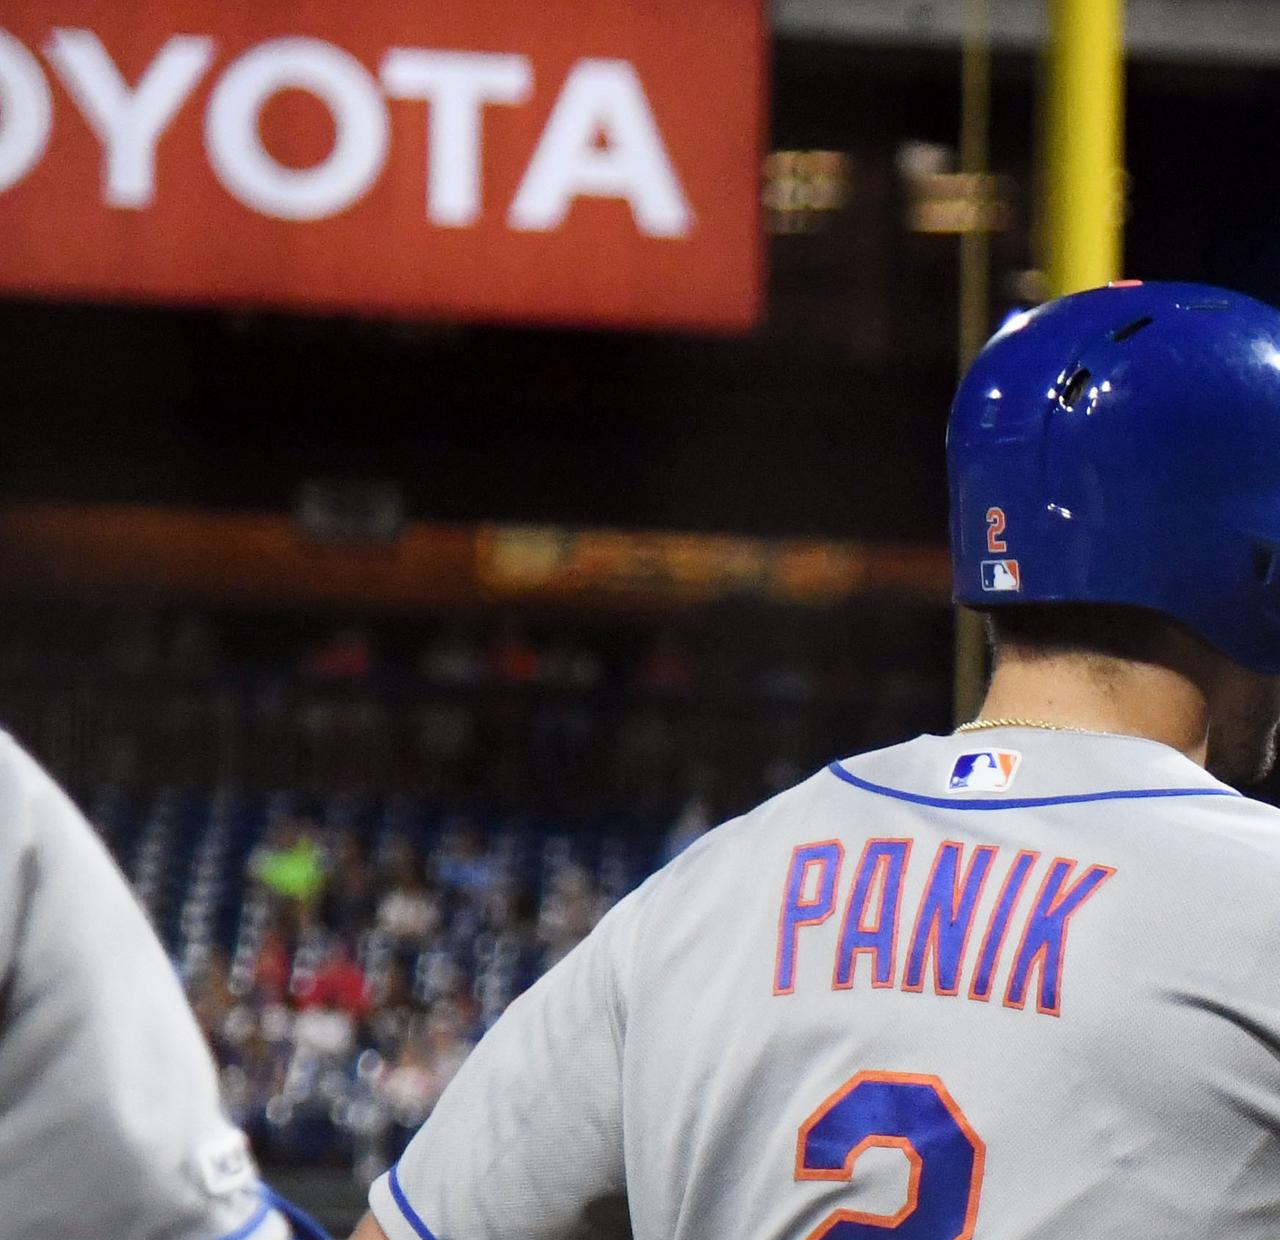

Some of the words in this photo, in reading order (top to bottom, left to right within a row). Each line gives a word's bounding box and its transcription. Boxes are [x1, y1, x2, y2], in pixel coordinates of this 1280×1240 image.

[0, 26, 695, 239] YOTA
[985, 506, 1007, 553] 2
[773, 837, 1117, 1018] PANIK
